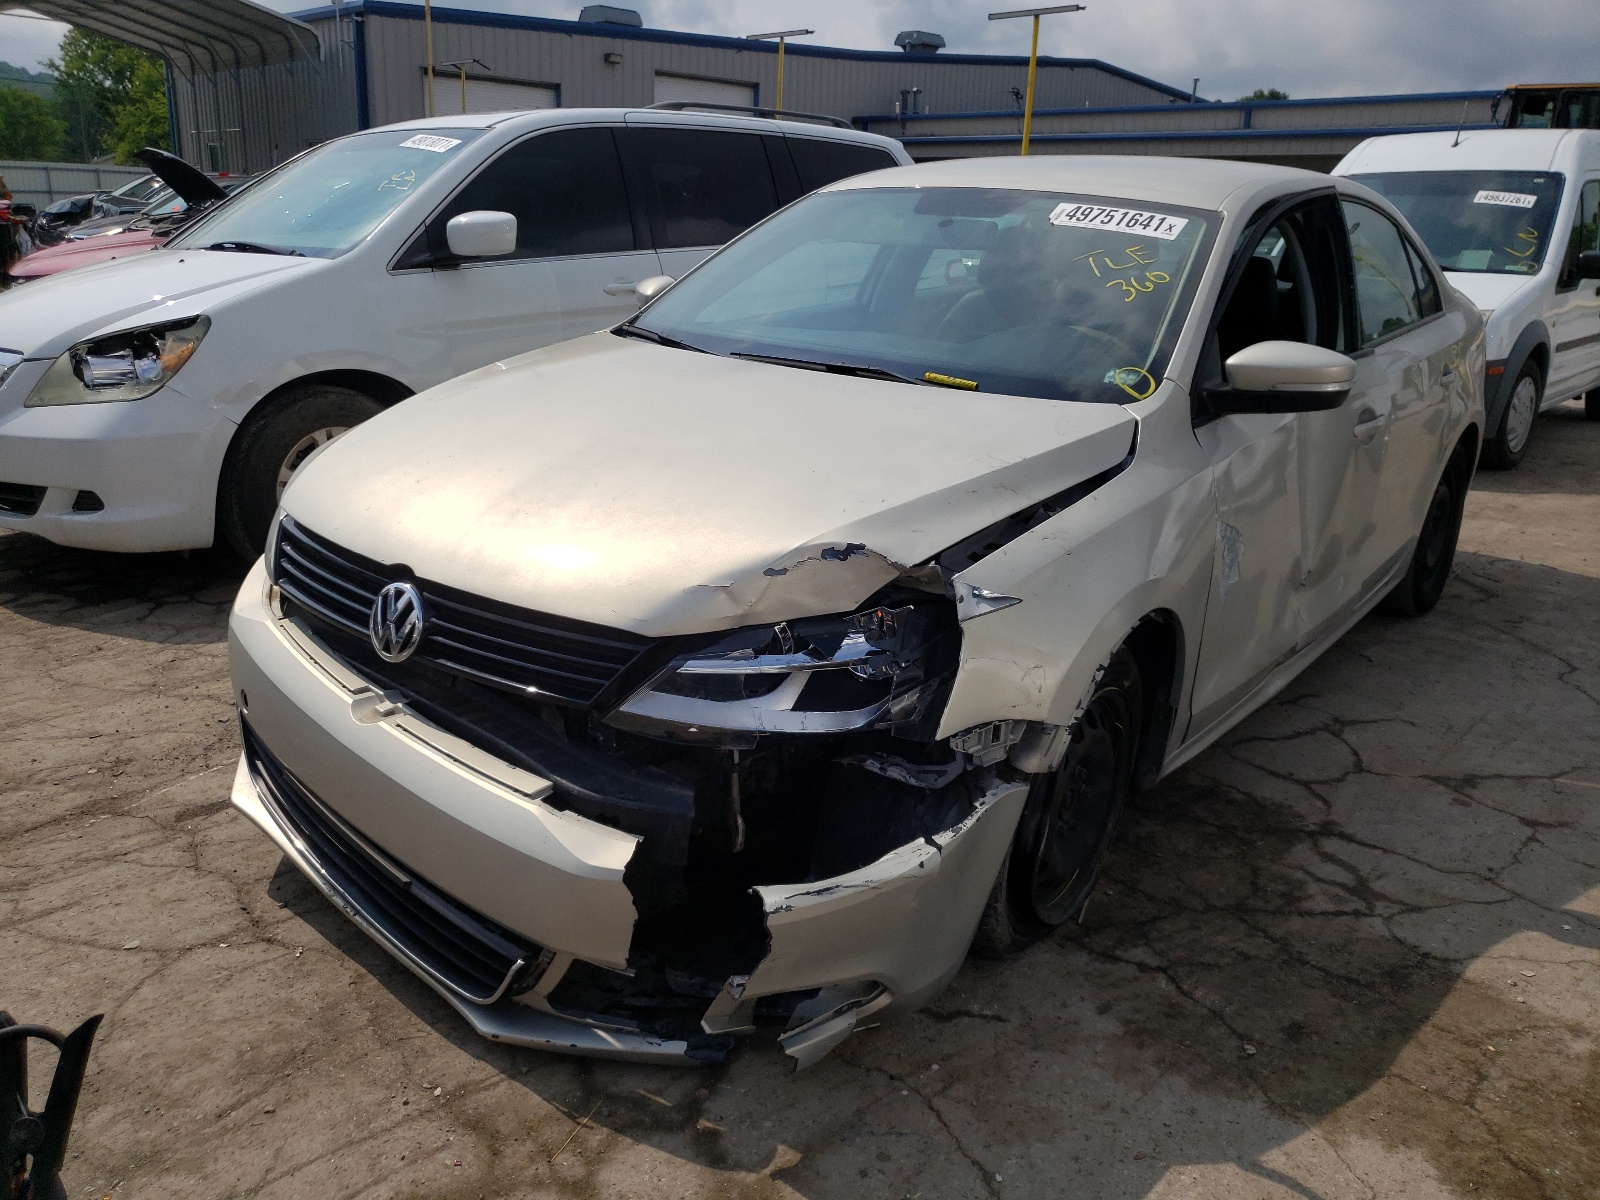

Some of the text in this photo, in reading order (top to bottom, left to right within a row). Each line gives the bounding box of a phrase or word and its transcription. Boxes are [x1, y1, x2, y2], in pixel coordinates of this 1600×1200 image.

[1065, 206, 1167, 231] 49751641
[1072, 244, 1159, 277] TLE
[1105, 271, 1170, 302] 360
